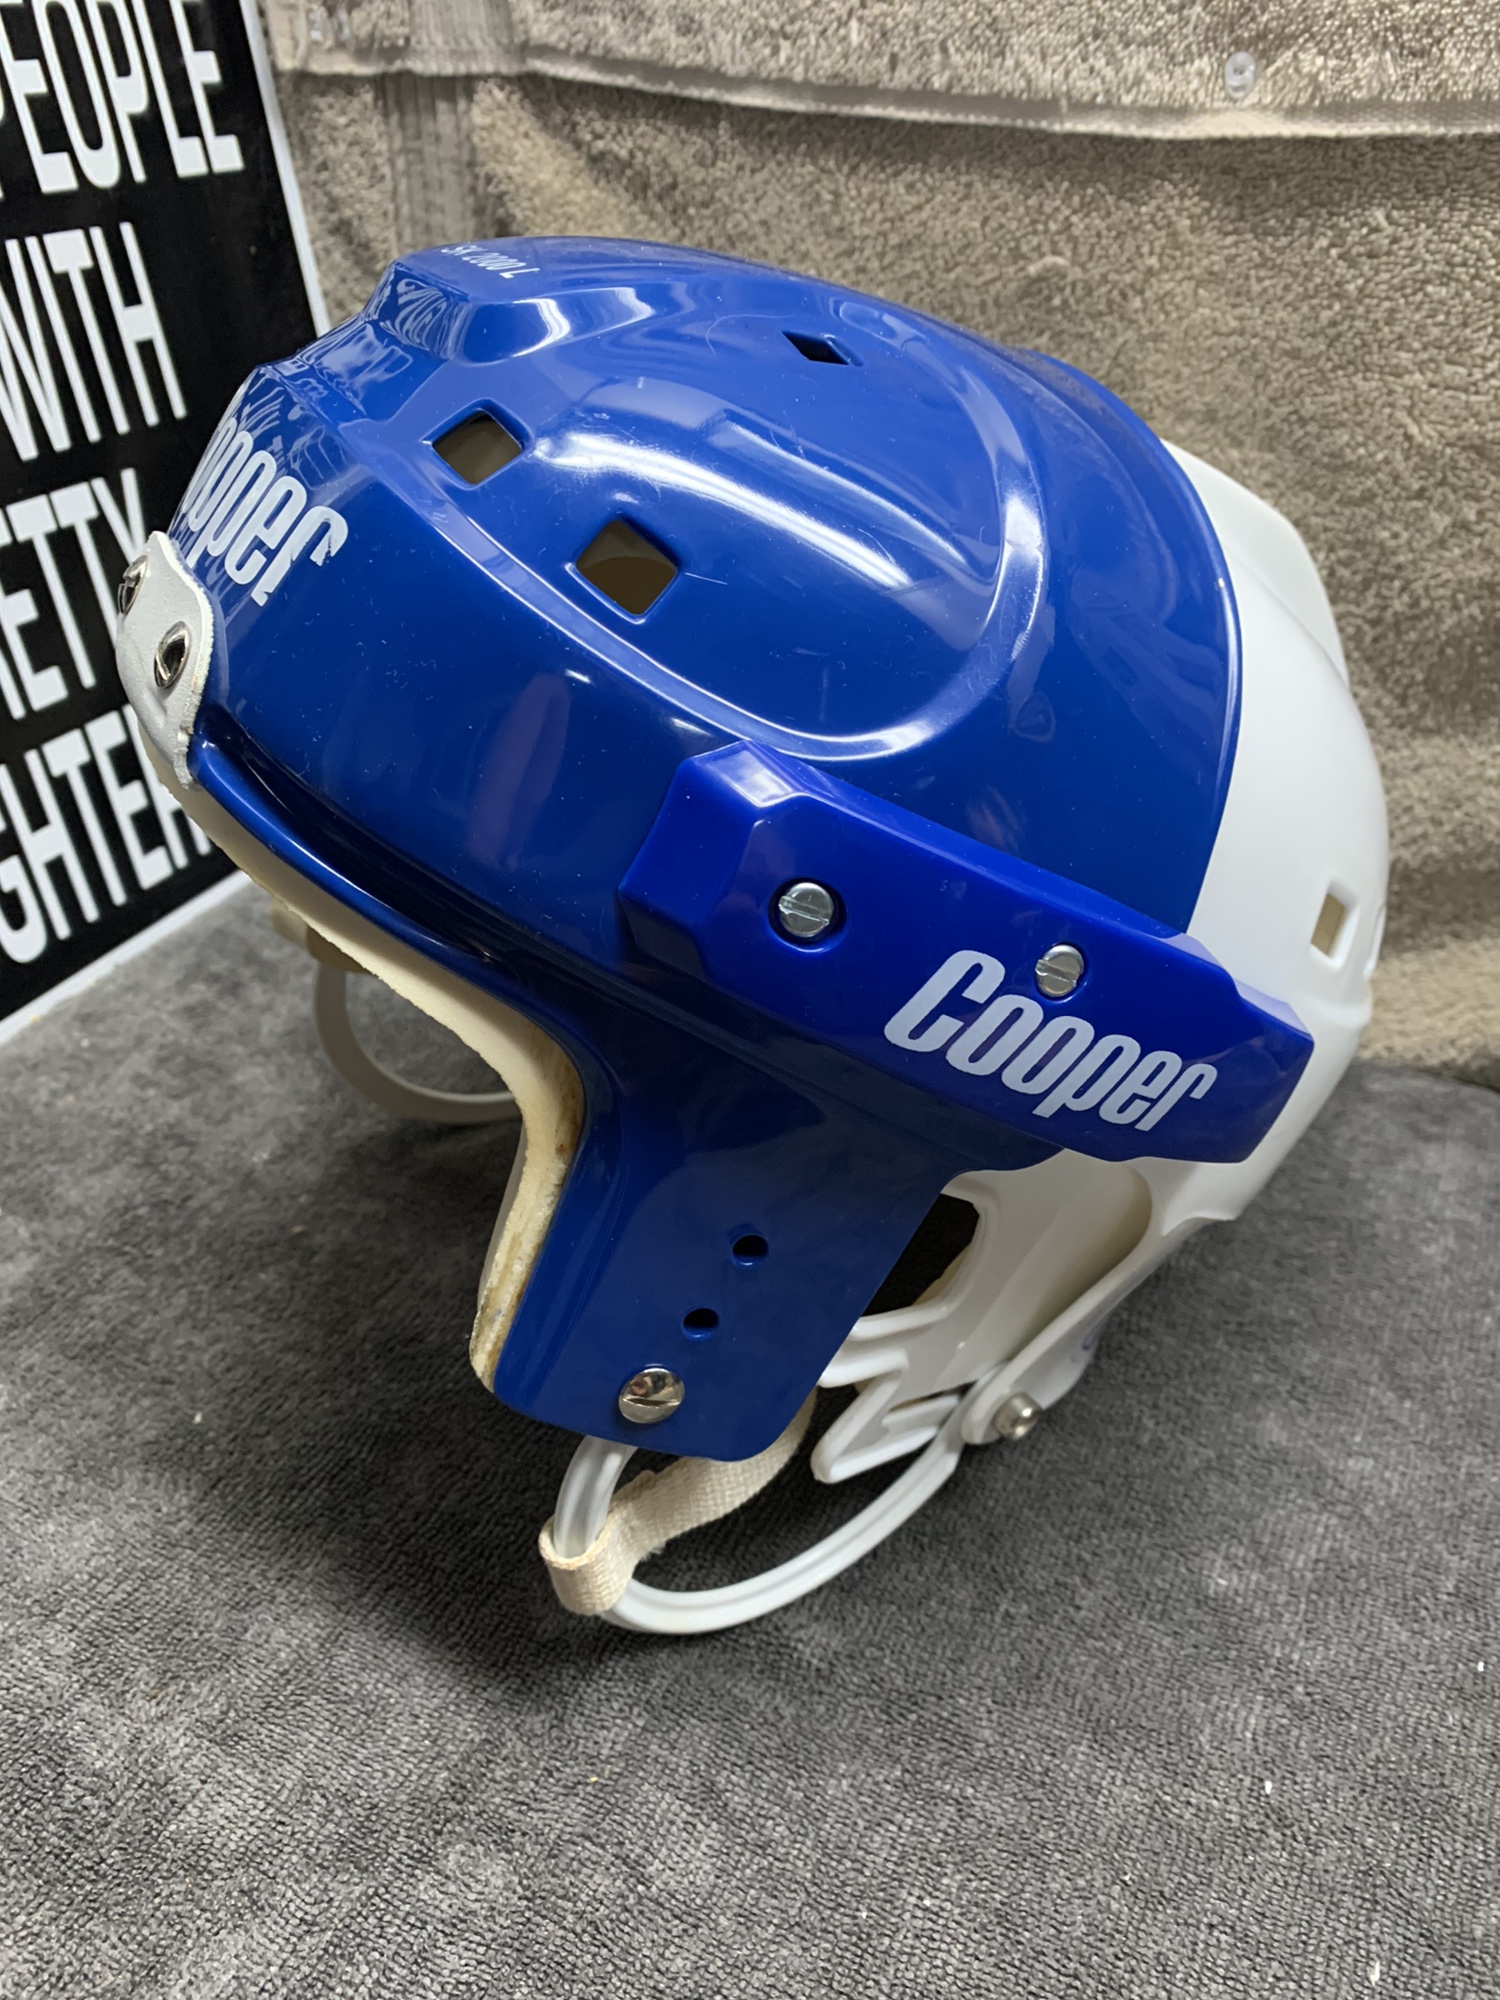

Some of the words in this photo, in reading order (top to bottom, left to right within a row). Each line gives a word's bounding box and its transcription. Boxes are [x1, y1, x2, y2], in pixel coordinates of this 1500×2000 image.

[0, 0, 244, 199] EOPLE
[0, 221, 187, 461] WITH
[884, 950, 1217, 1131] Cooper
